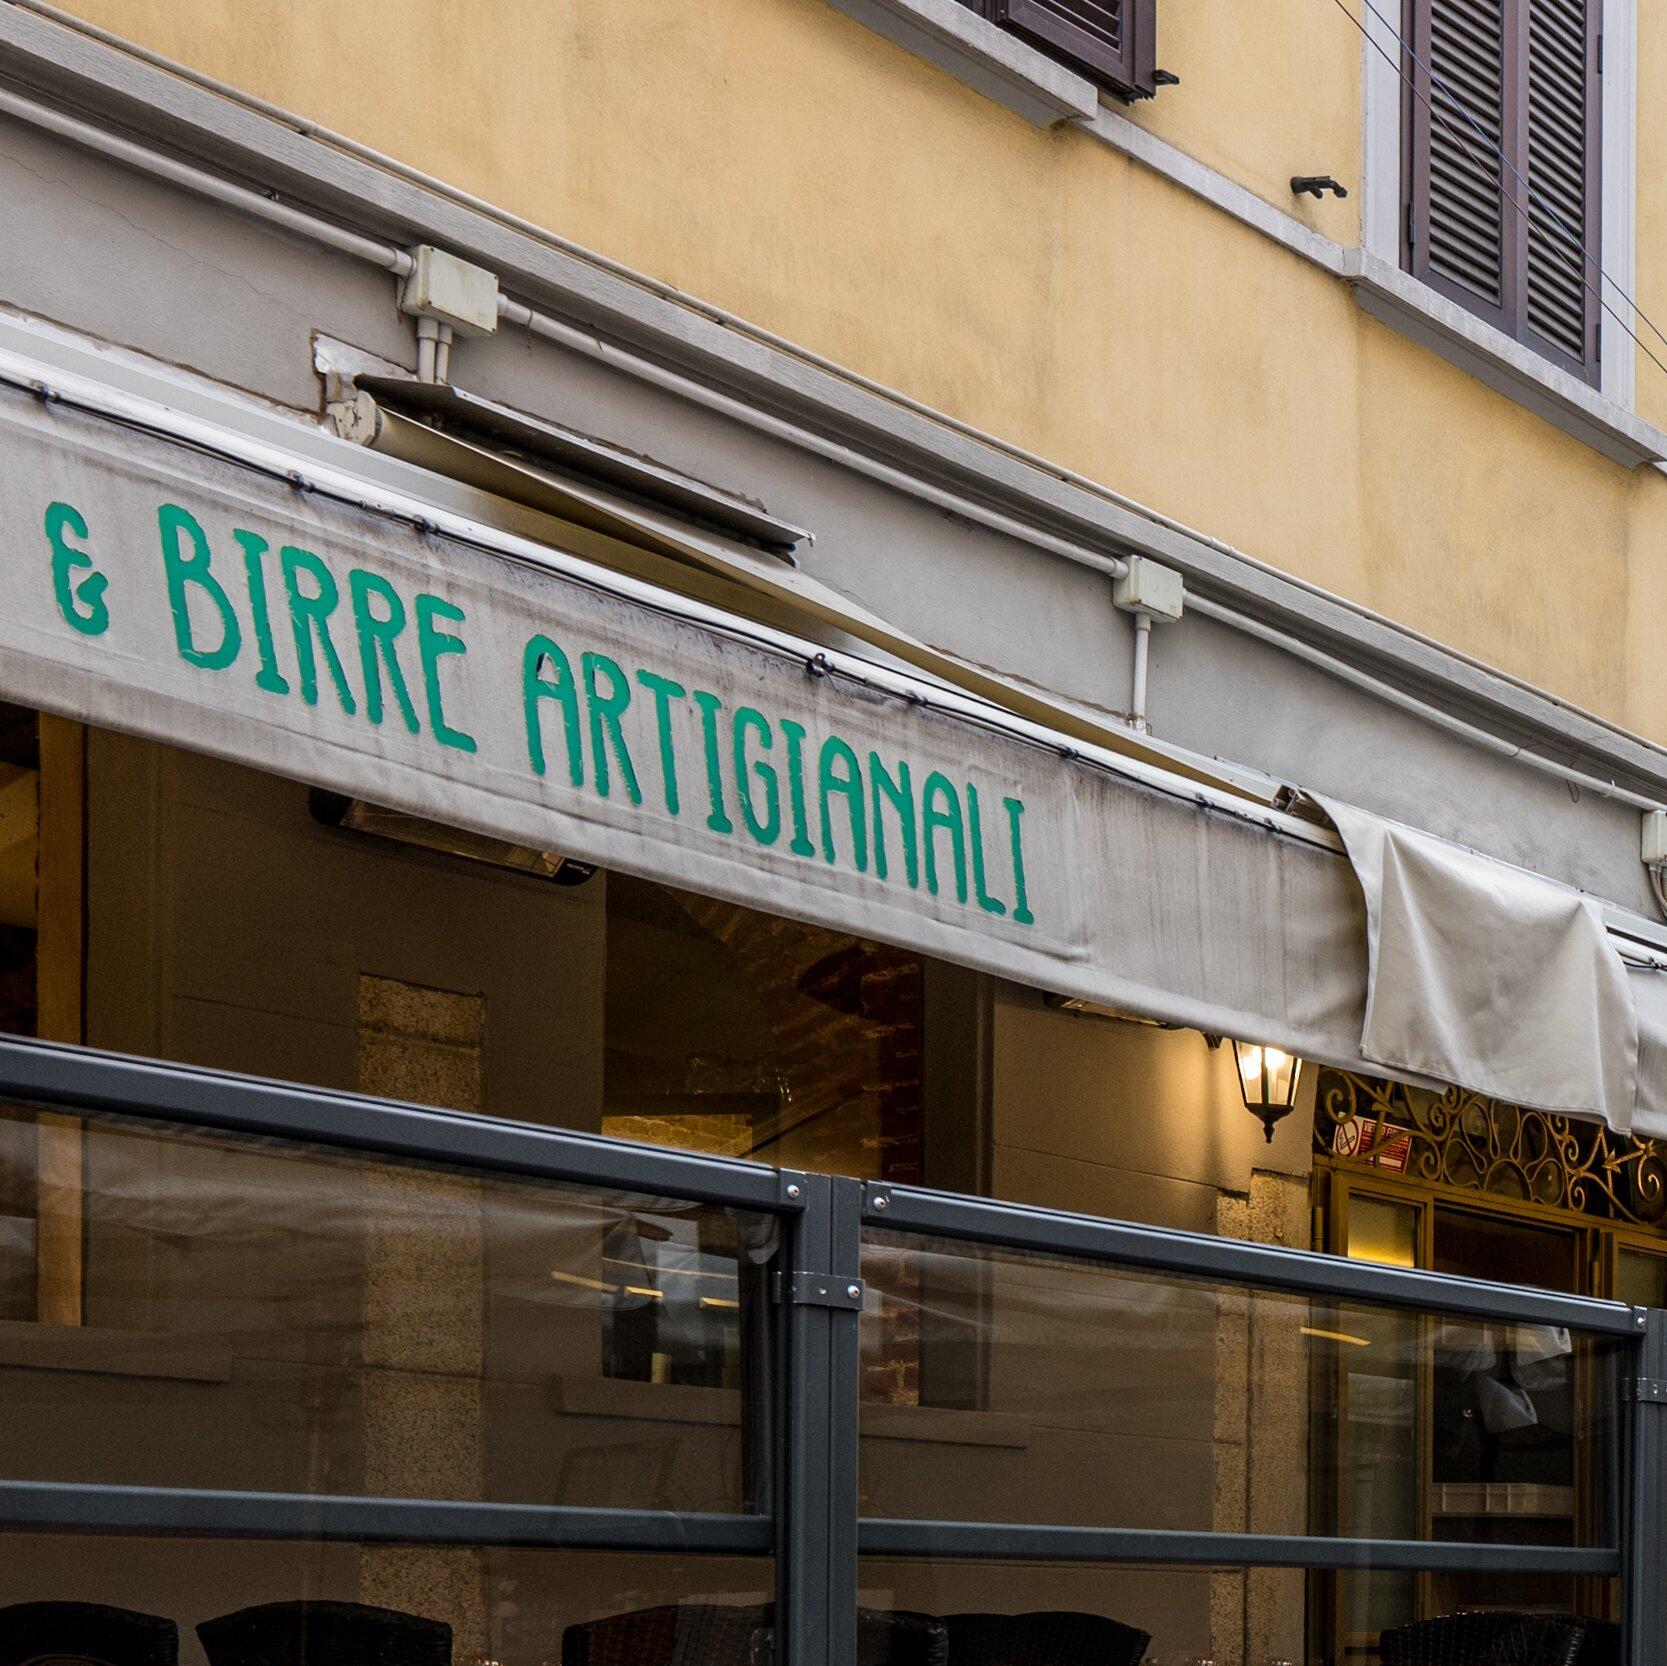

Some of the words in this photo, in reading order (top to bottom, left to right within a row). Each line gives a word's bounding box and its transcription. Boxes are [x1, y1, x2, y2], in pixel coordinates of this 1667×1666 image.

[45, 500, 110, 637] &
[157, 502, 478, 754] BIRRE
[522, 633, 1036, 927] ARTIGIANALI
